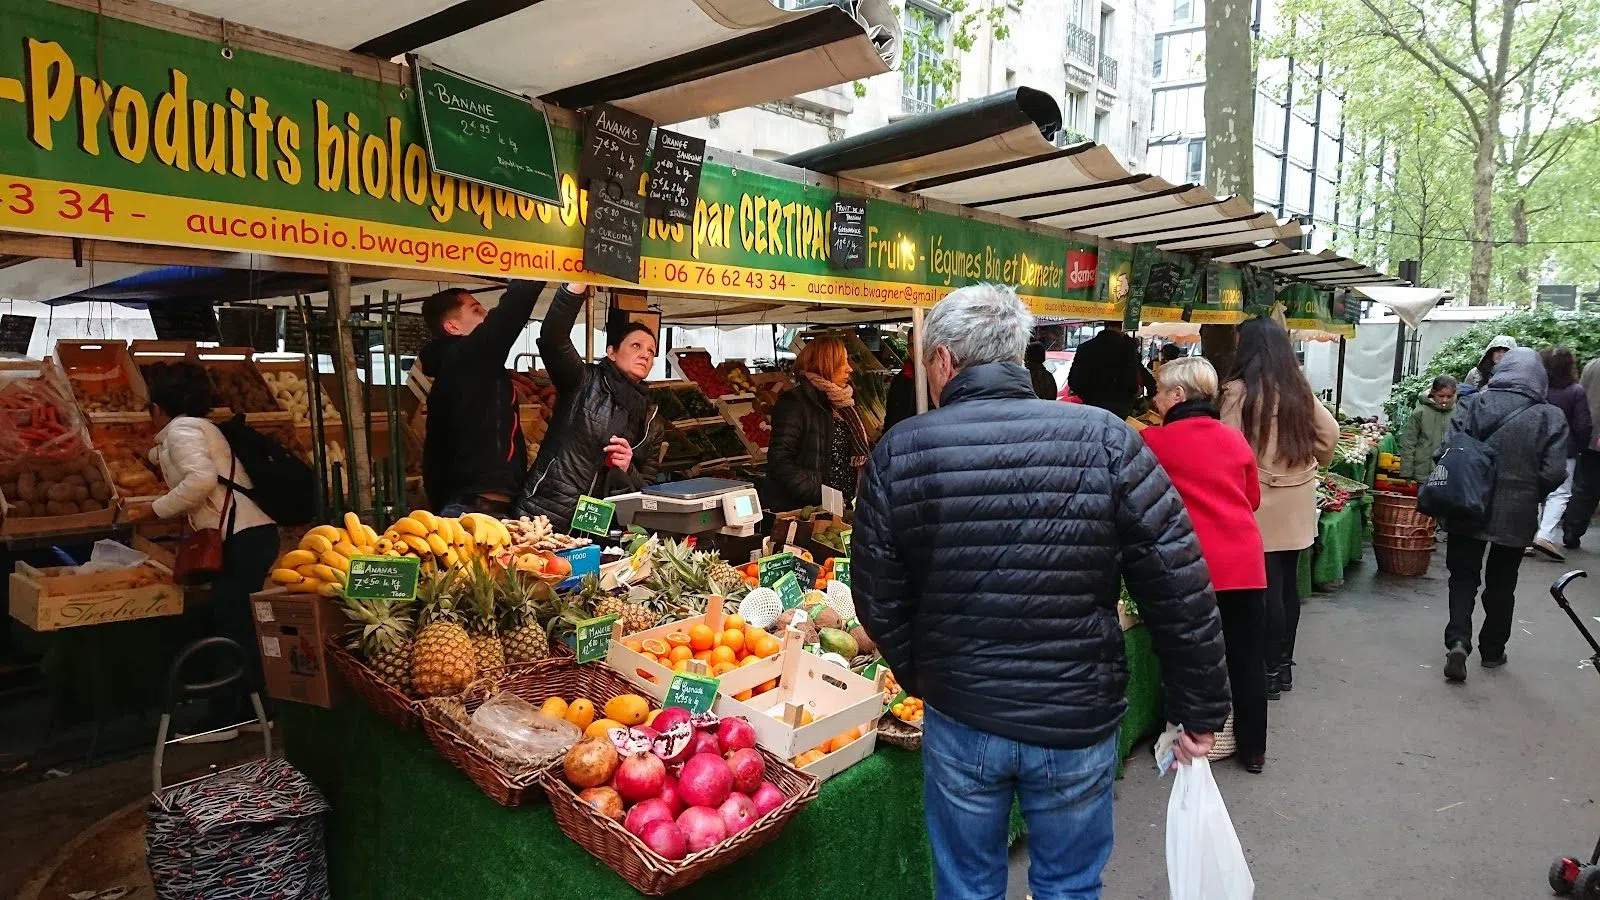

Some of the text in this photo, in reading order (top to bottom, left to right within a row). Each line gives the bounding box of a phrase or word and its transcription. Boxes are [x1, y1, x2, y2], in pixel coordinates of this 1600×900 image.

[434, 83, 494, 117] BANANE
[595, 110, 638, 140] ANANAS
[661, 133, 689, 149] ORANGE
[0, 183, 34, 214] 3
[58, 189, 114, 222] 34
[186, 214, 598, 273] aucoinbio.bwagner@gmail.co
[693, 197, 735, 259] par
[868, 226, 916, 272] Fruits
[930, 235, 981, 285] légumes
[985, 245, 1000, 281] Bio
[1003, 253, 1018, 282] et
[1020, 252, 1063, 288] Demeter
[1070, 261, 1096, 284] deme
[665, 263, 688, 283] 06
[696, 266, 715, 285] 76
[722, 269, 740, 287] 62
[746, 271, 763, 289] 43
[769, 274, 786, 290] 34
[807, 280, 950, 304] aucoinbio.bwagner@gmail.co
[364, 564, 398, 574] ANANAS
[572, 552, 587, 561] FOOD
